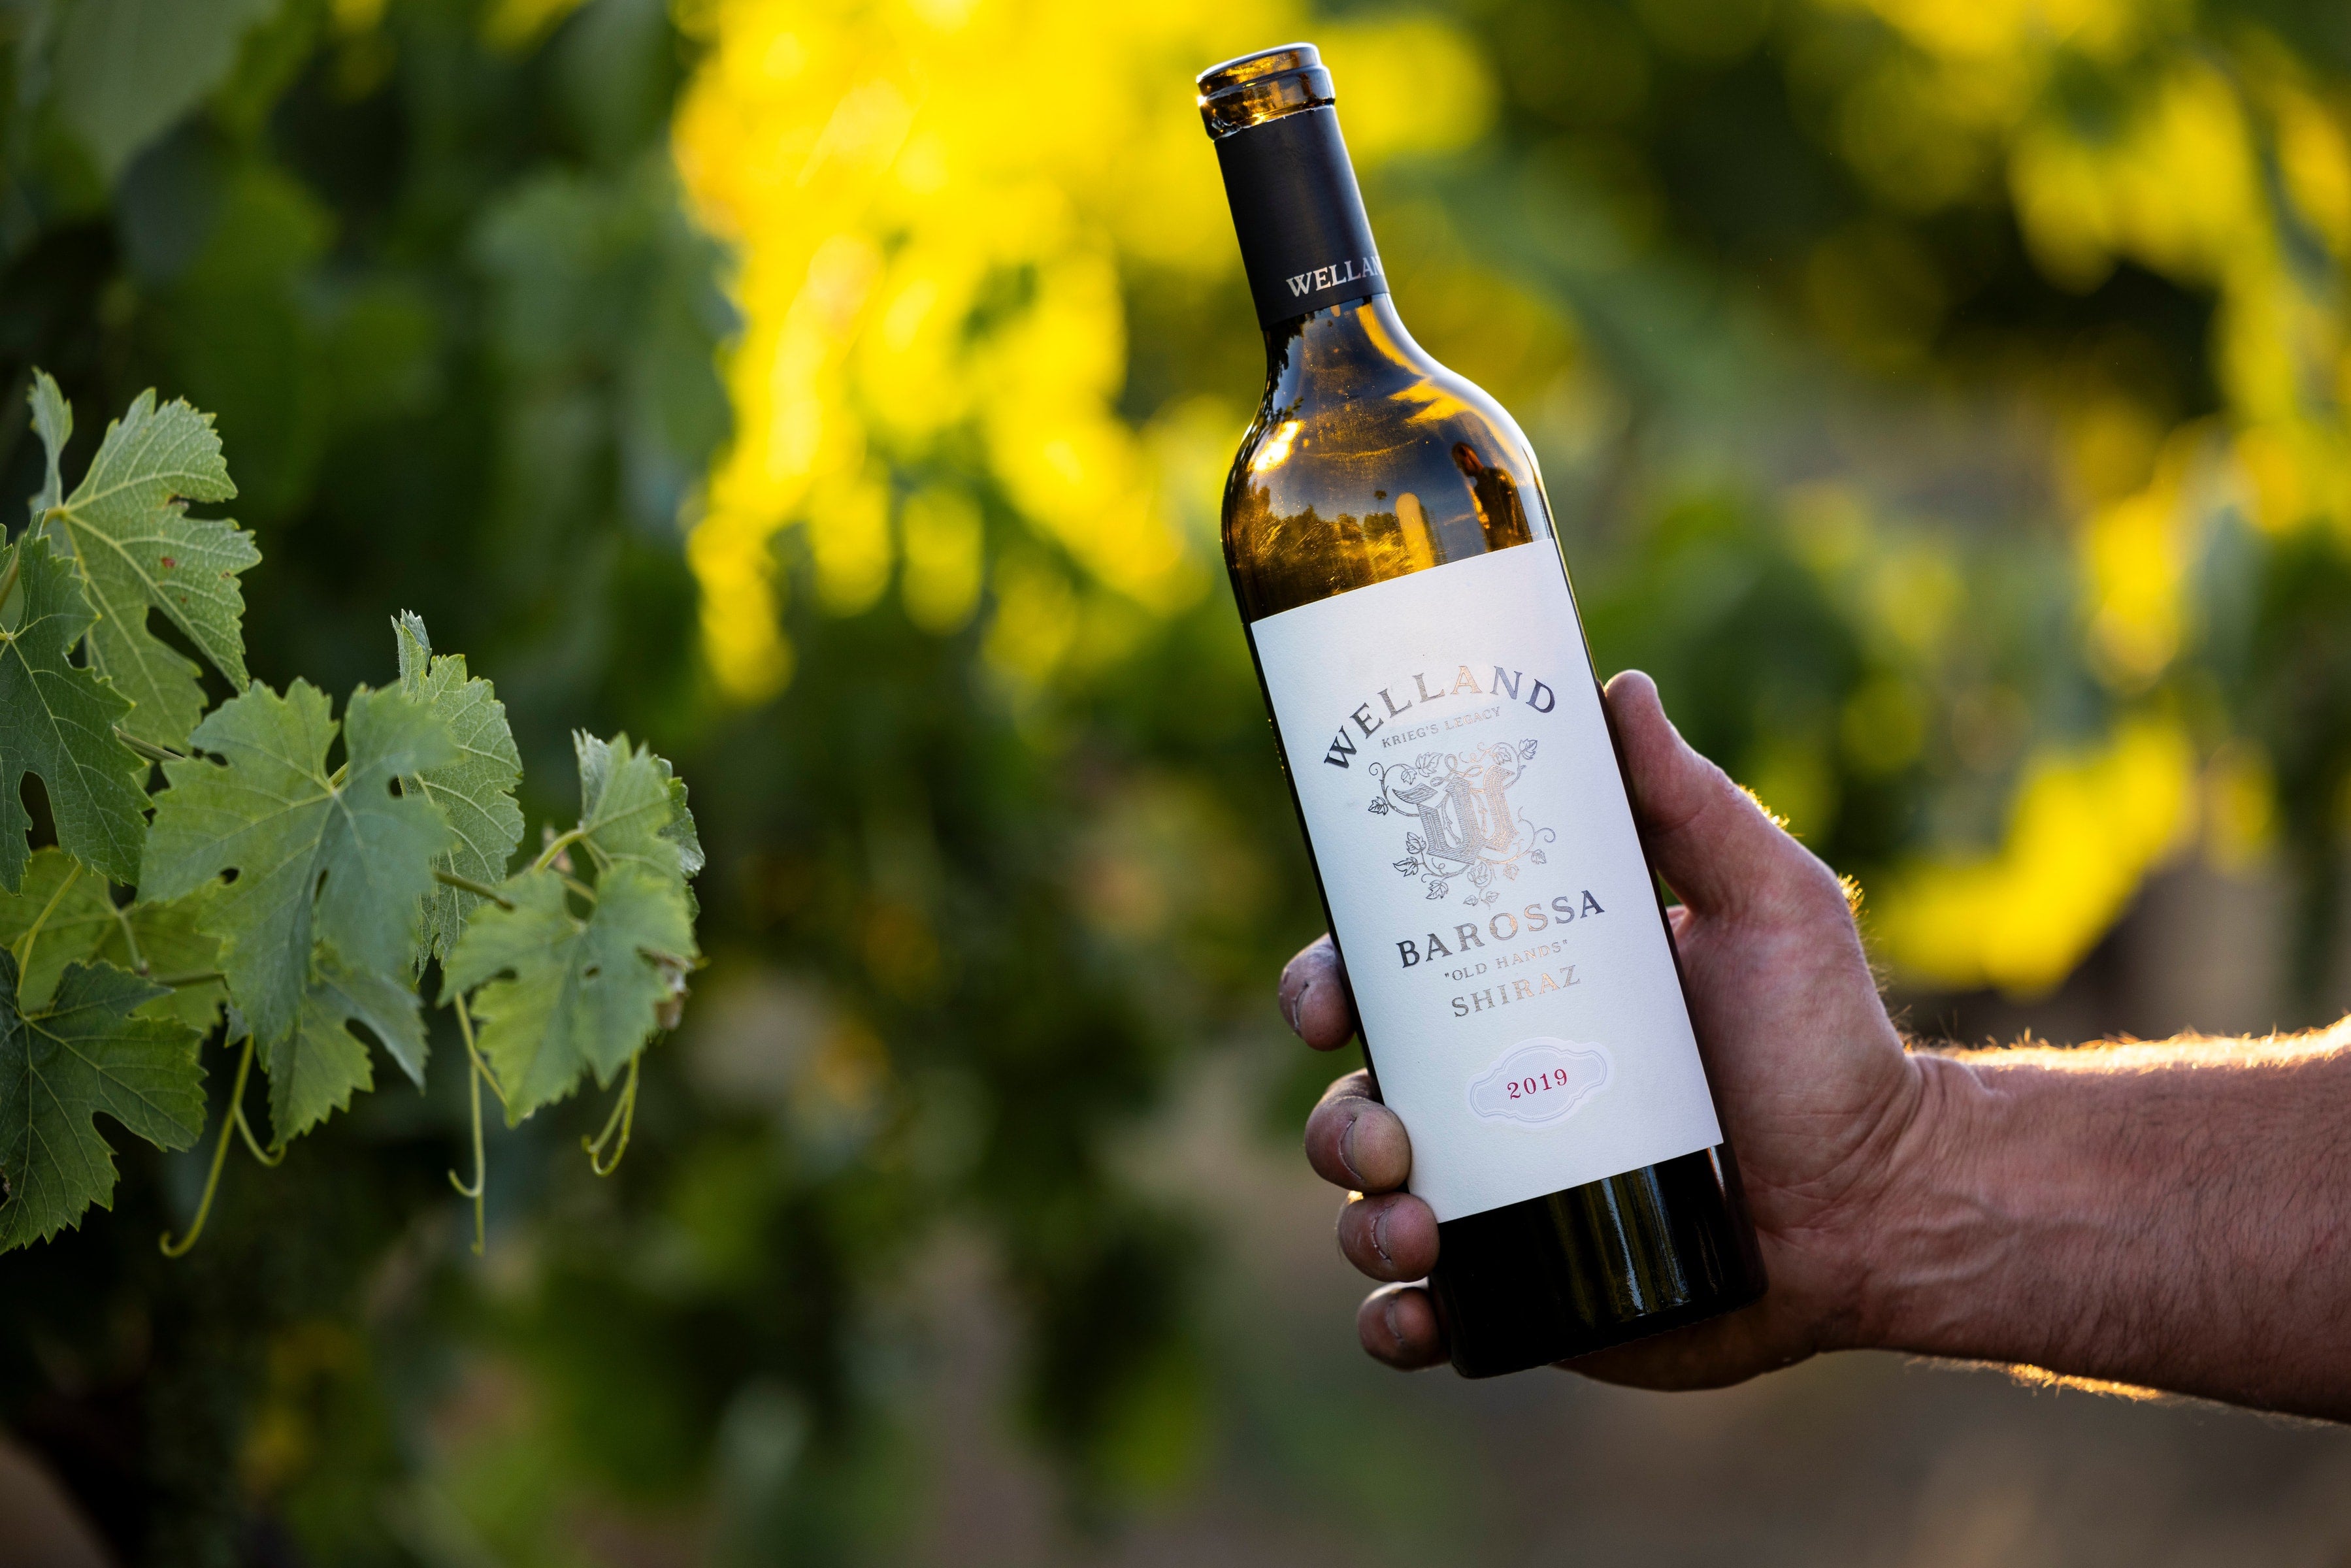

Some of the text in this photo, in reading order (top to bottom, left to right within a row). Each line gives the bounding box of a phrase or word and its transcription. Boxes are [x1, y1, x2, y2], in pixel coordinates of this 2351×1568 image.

[1324, 666, 1555, 768] WELLAND
[1382, 706, 1500, 748] KRIEG'S LEGACY
[1396, 890, 1605, 968] BAROSSA
[1445, 939, 1568, 981] "OLD HANDS"
[1451, 965, 1581, 1017] SHIRAZ
[1507, 1069, 1568, 1100] 2019
